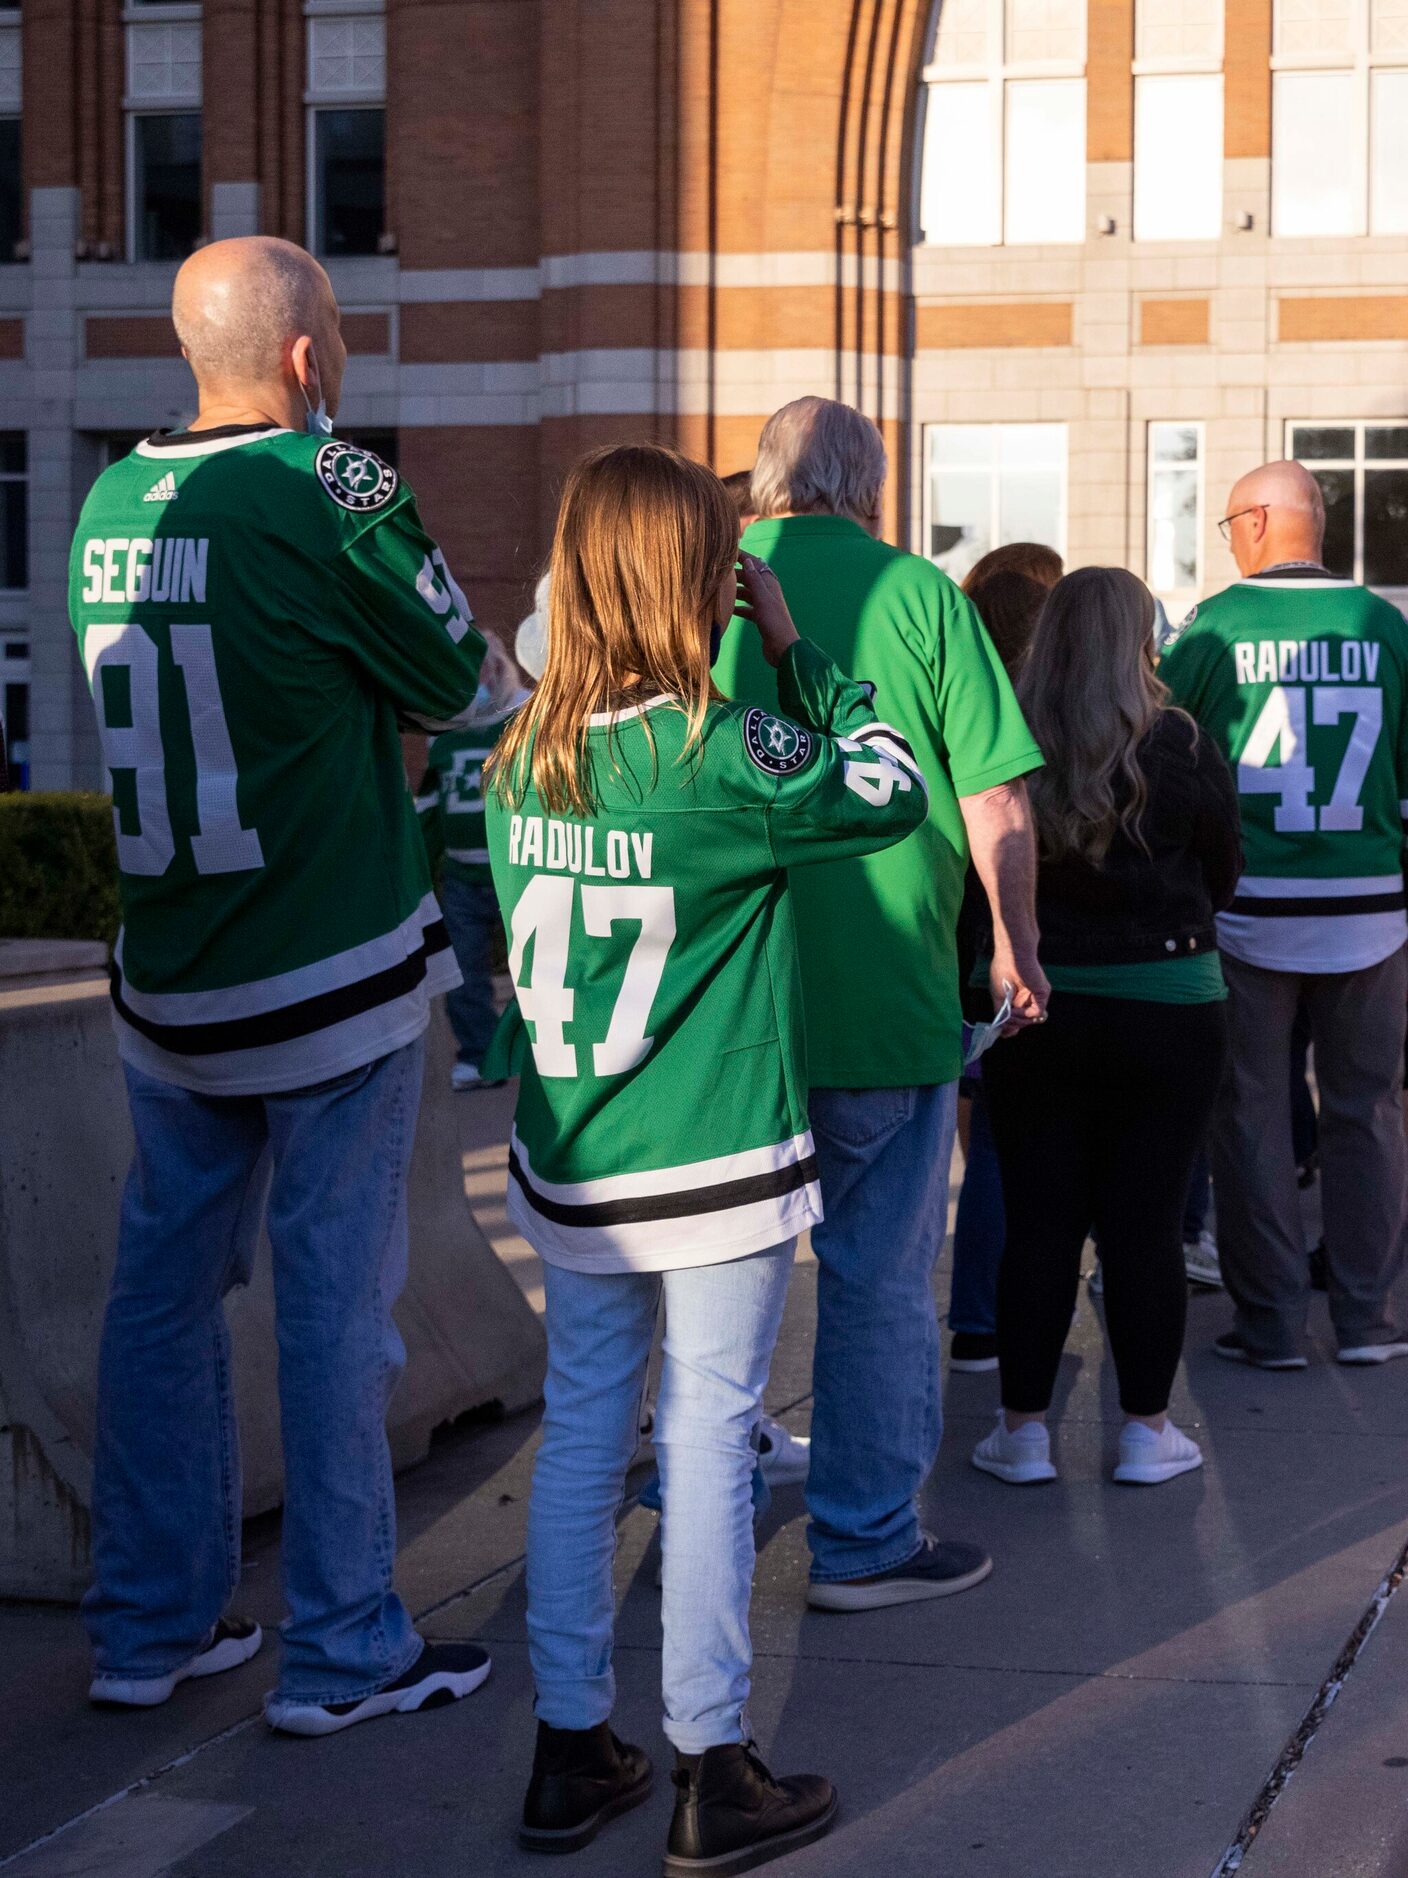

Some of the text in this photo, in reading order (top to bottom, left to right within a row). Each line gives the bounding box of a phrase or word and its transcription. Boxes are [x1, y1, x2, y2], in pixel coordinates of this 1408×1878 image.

[143, 489, 179, 502] adidas
[345, 468, 393, 507] STARS
[82, 537, 209, 603] SEGUIN
[1235, 640, 1380, 684] RADULOV
[84, 623, 266, 876] 91
[1237, 686, 1383, 832] 47
[509, 814, 654, 879] RADULOV
[508, 874, 677, 1078] 47
